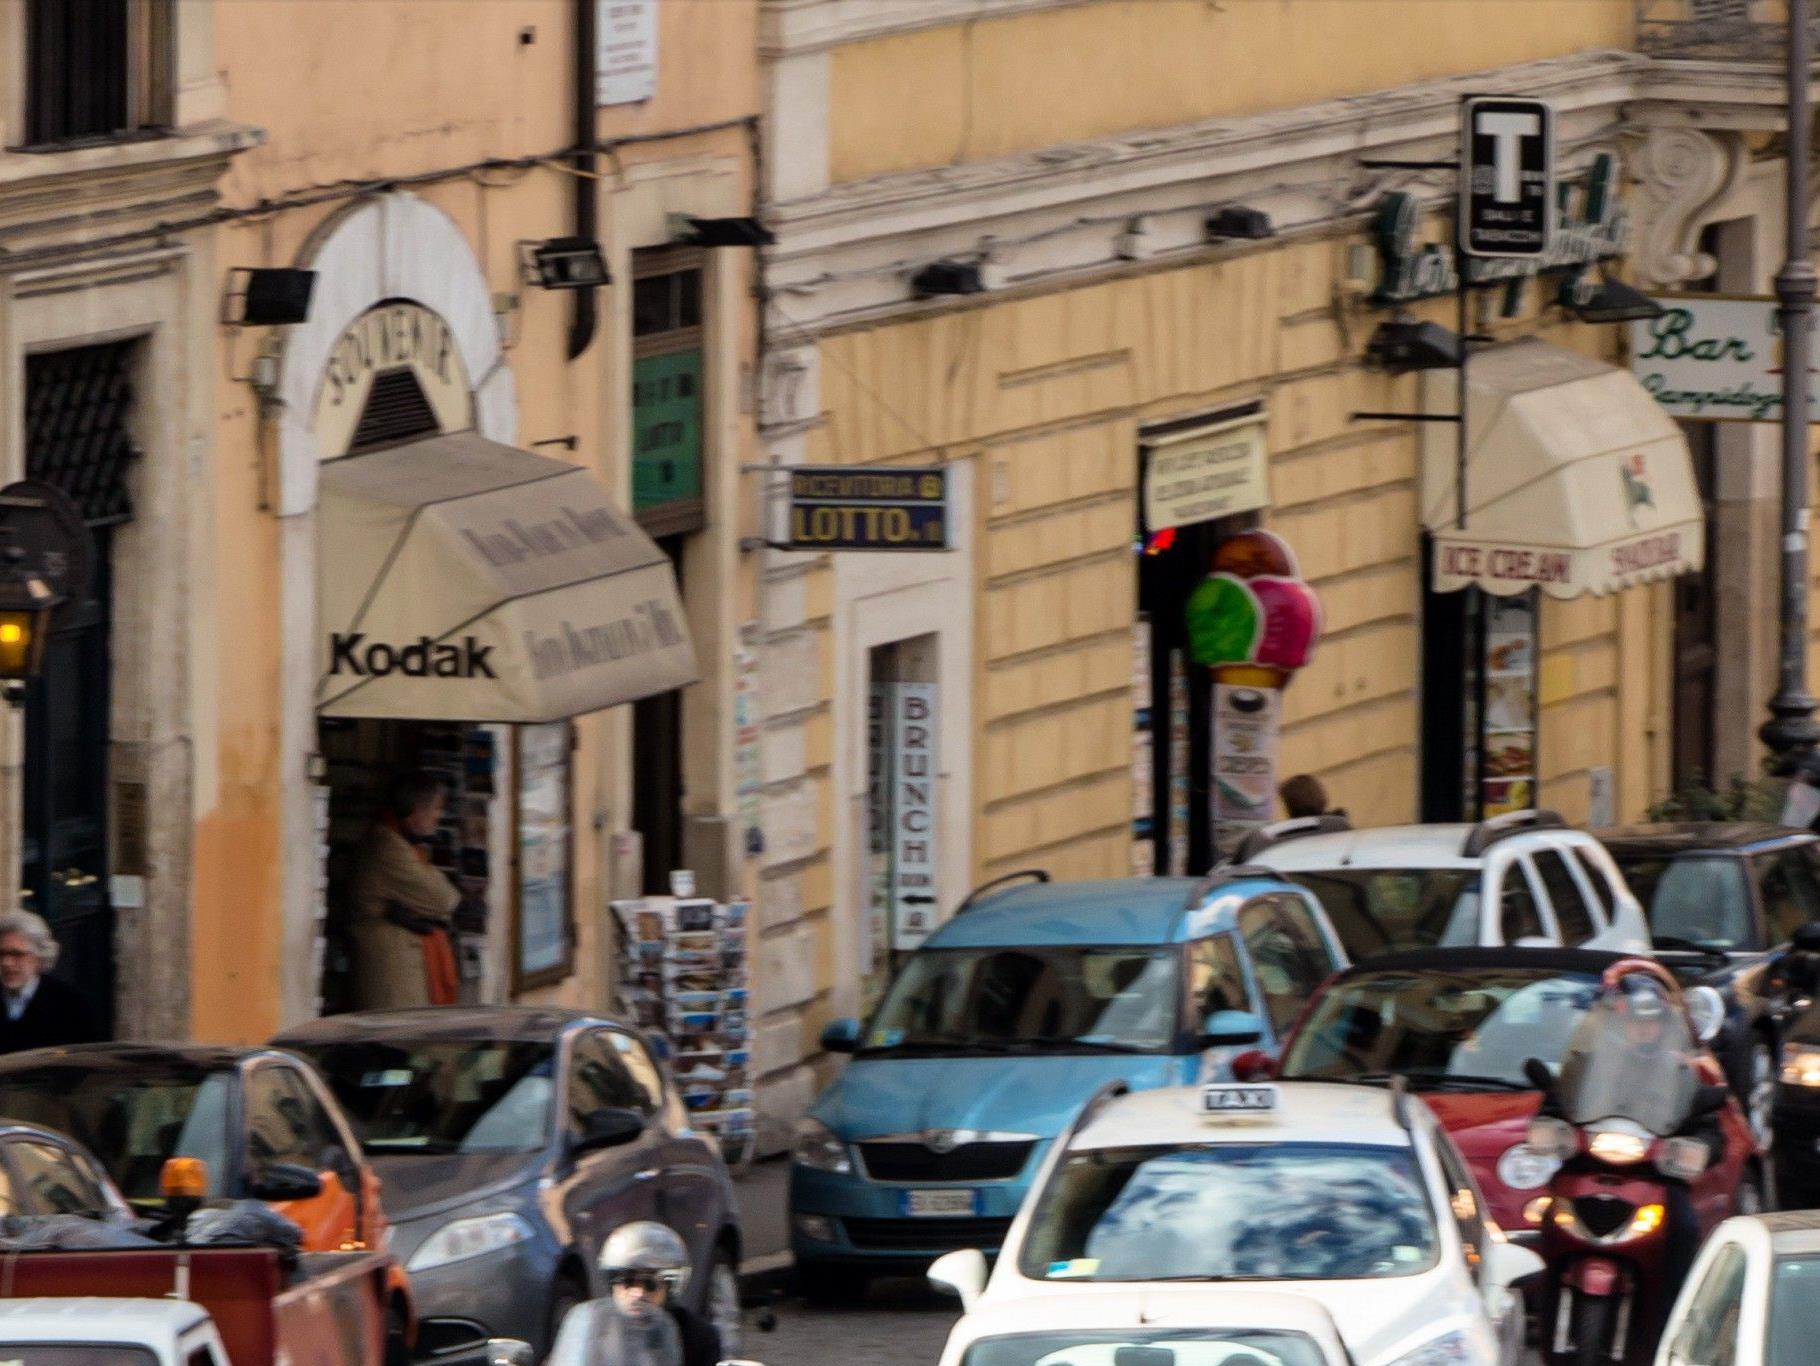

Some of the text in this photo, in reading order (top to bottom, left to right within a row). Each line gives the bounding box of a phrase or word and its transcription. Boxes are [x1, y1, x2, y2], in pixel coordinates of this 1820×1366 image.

[1476, 112, 1540, 203] T
[1639, 308, 1754, 361] Bar
[793, 508, 910, 542] LOTTO
[1441, 547, 1571, 583] ICE CREAM
[329, 632, 498, 680] Kodak
[903, 696, 929, 862] BRUNCH
[1208, 1090, 1273, 1108] TAXI
